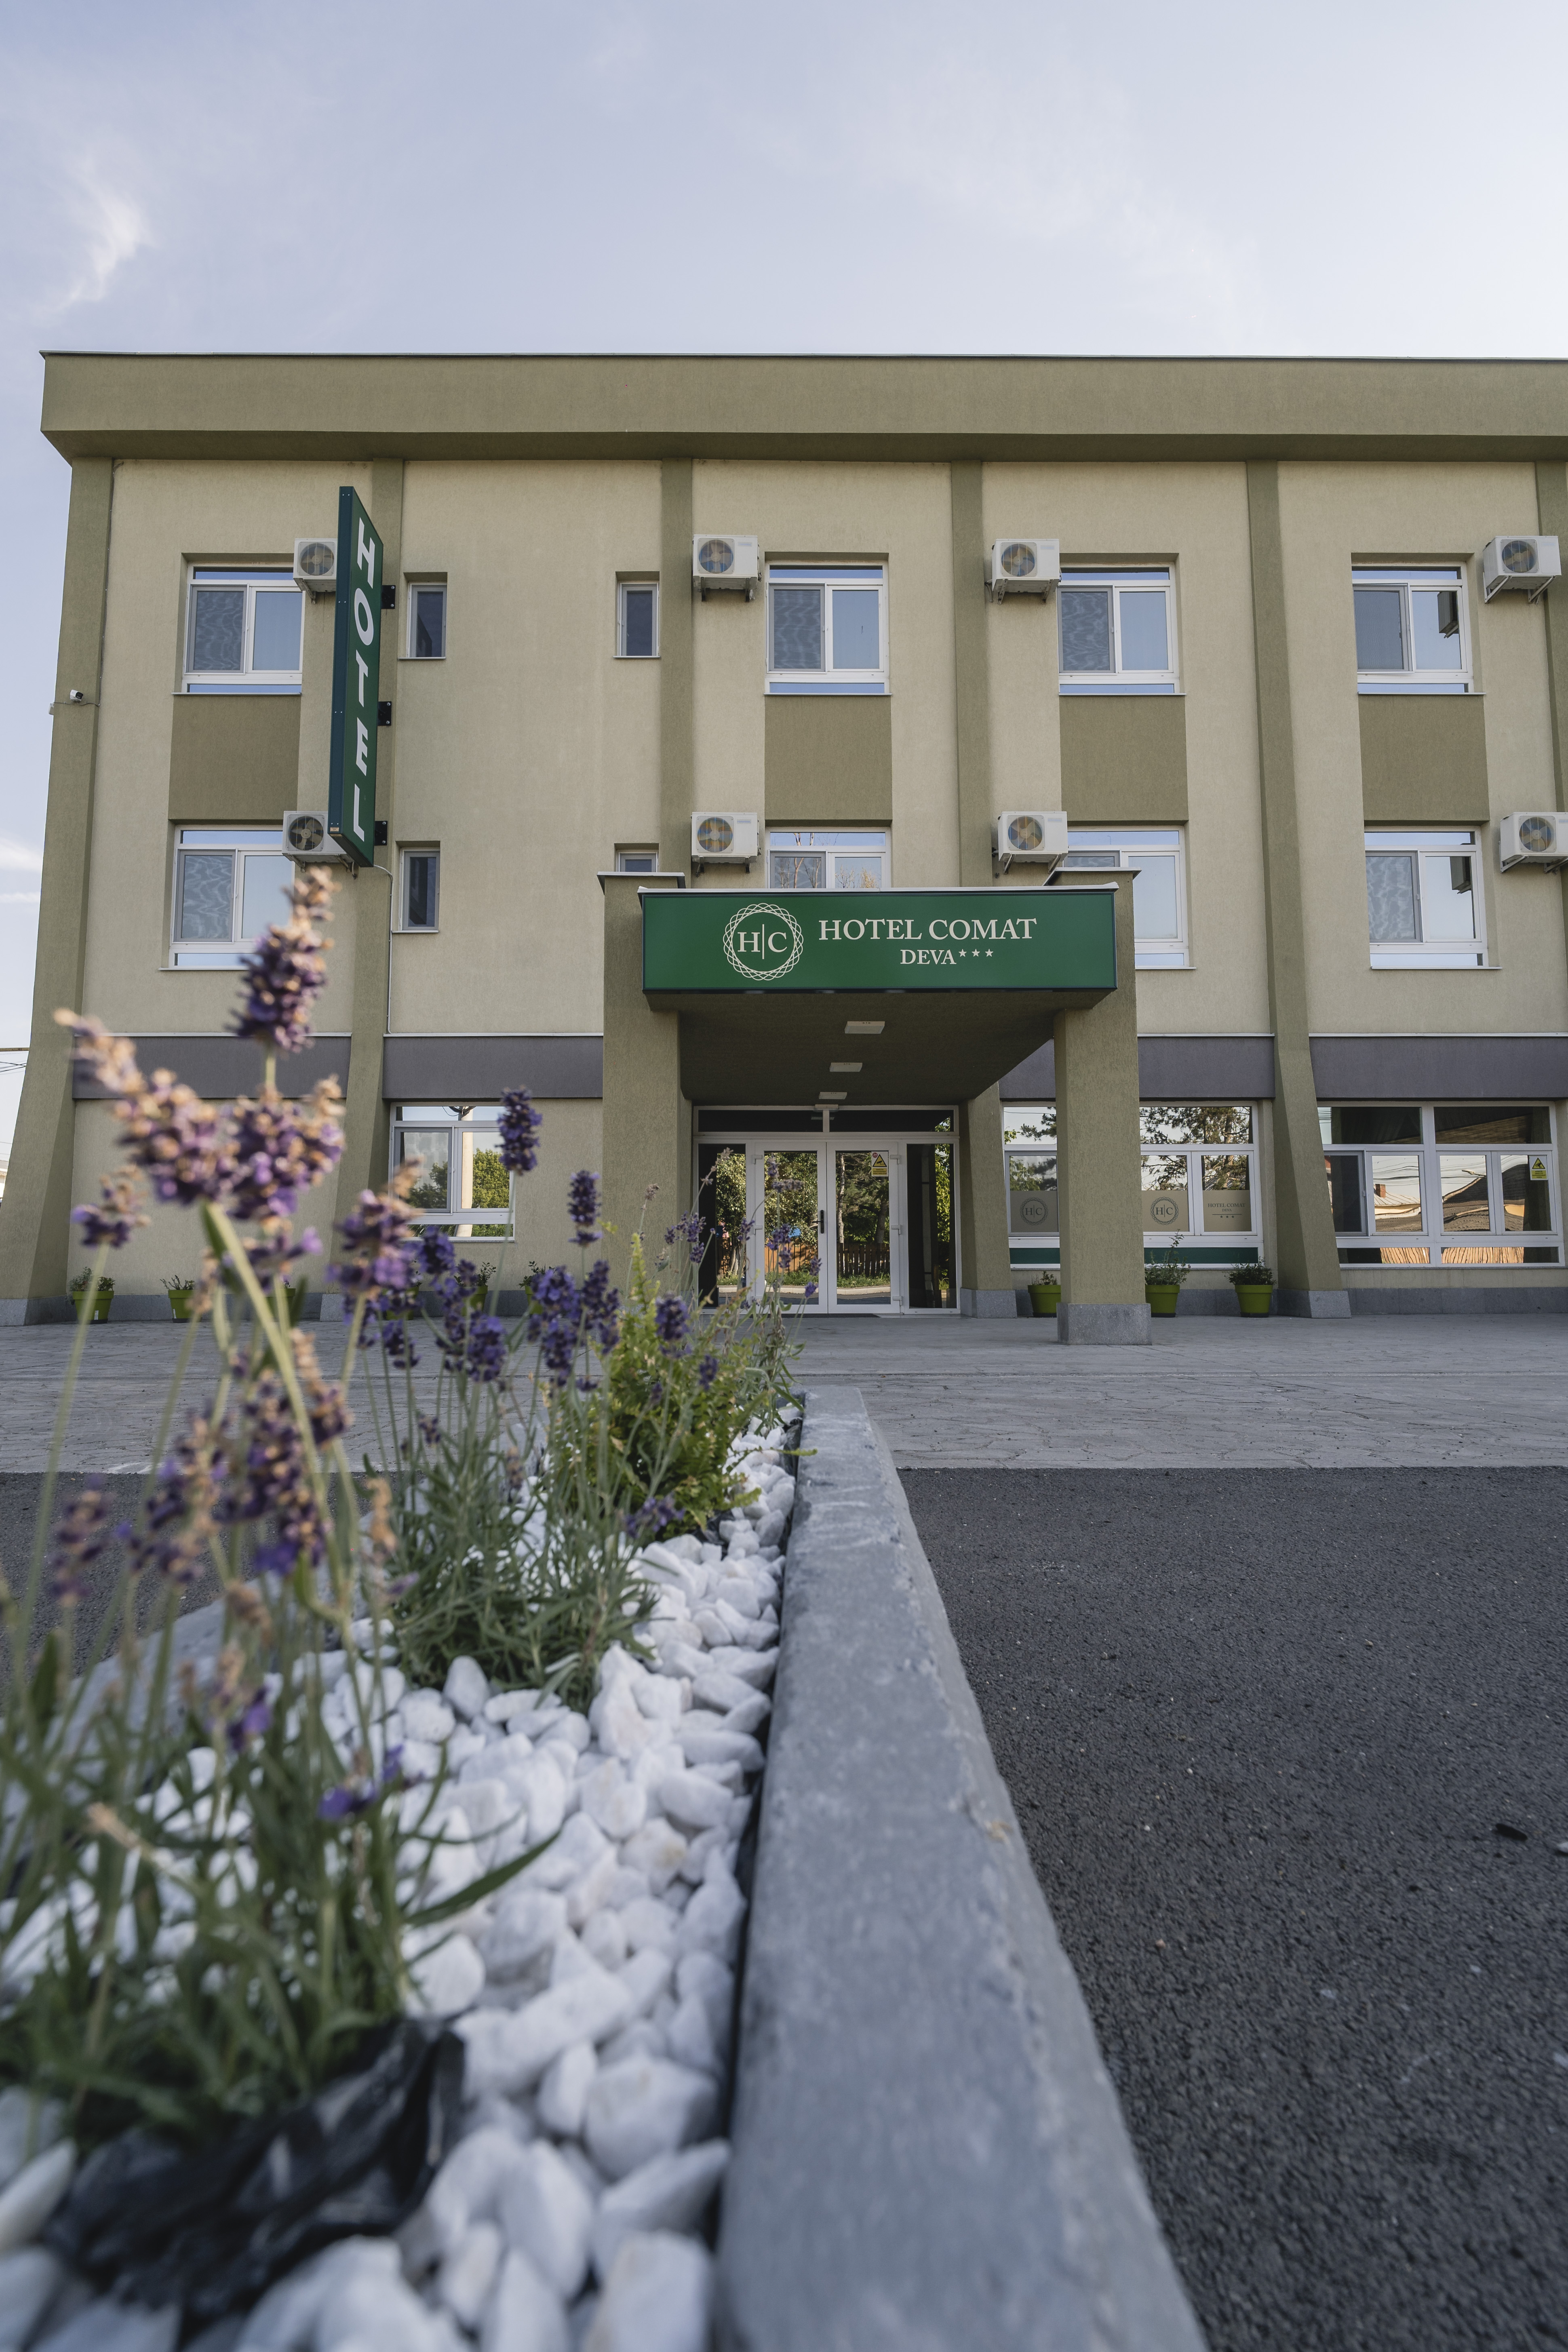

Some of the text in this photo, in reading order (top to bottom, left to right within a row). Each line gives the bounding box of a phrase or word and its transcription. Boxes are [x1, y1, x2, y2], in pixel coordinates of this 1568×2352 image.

[354, 517, 375, 842] HOTEL
[819, 918, 1037, 940] HOTEL COMAT
[900, 949, 957, 965] DEVA
